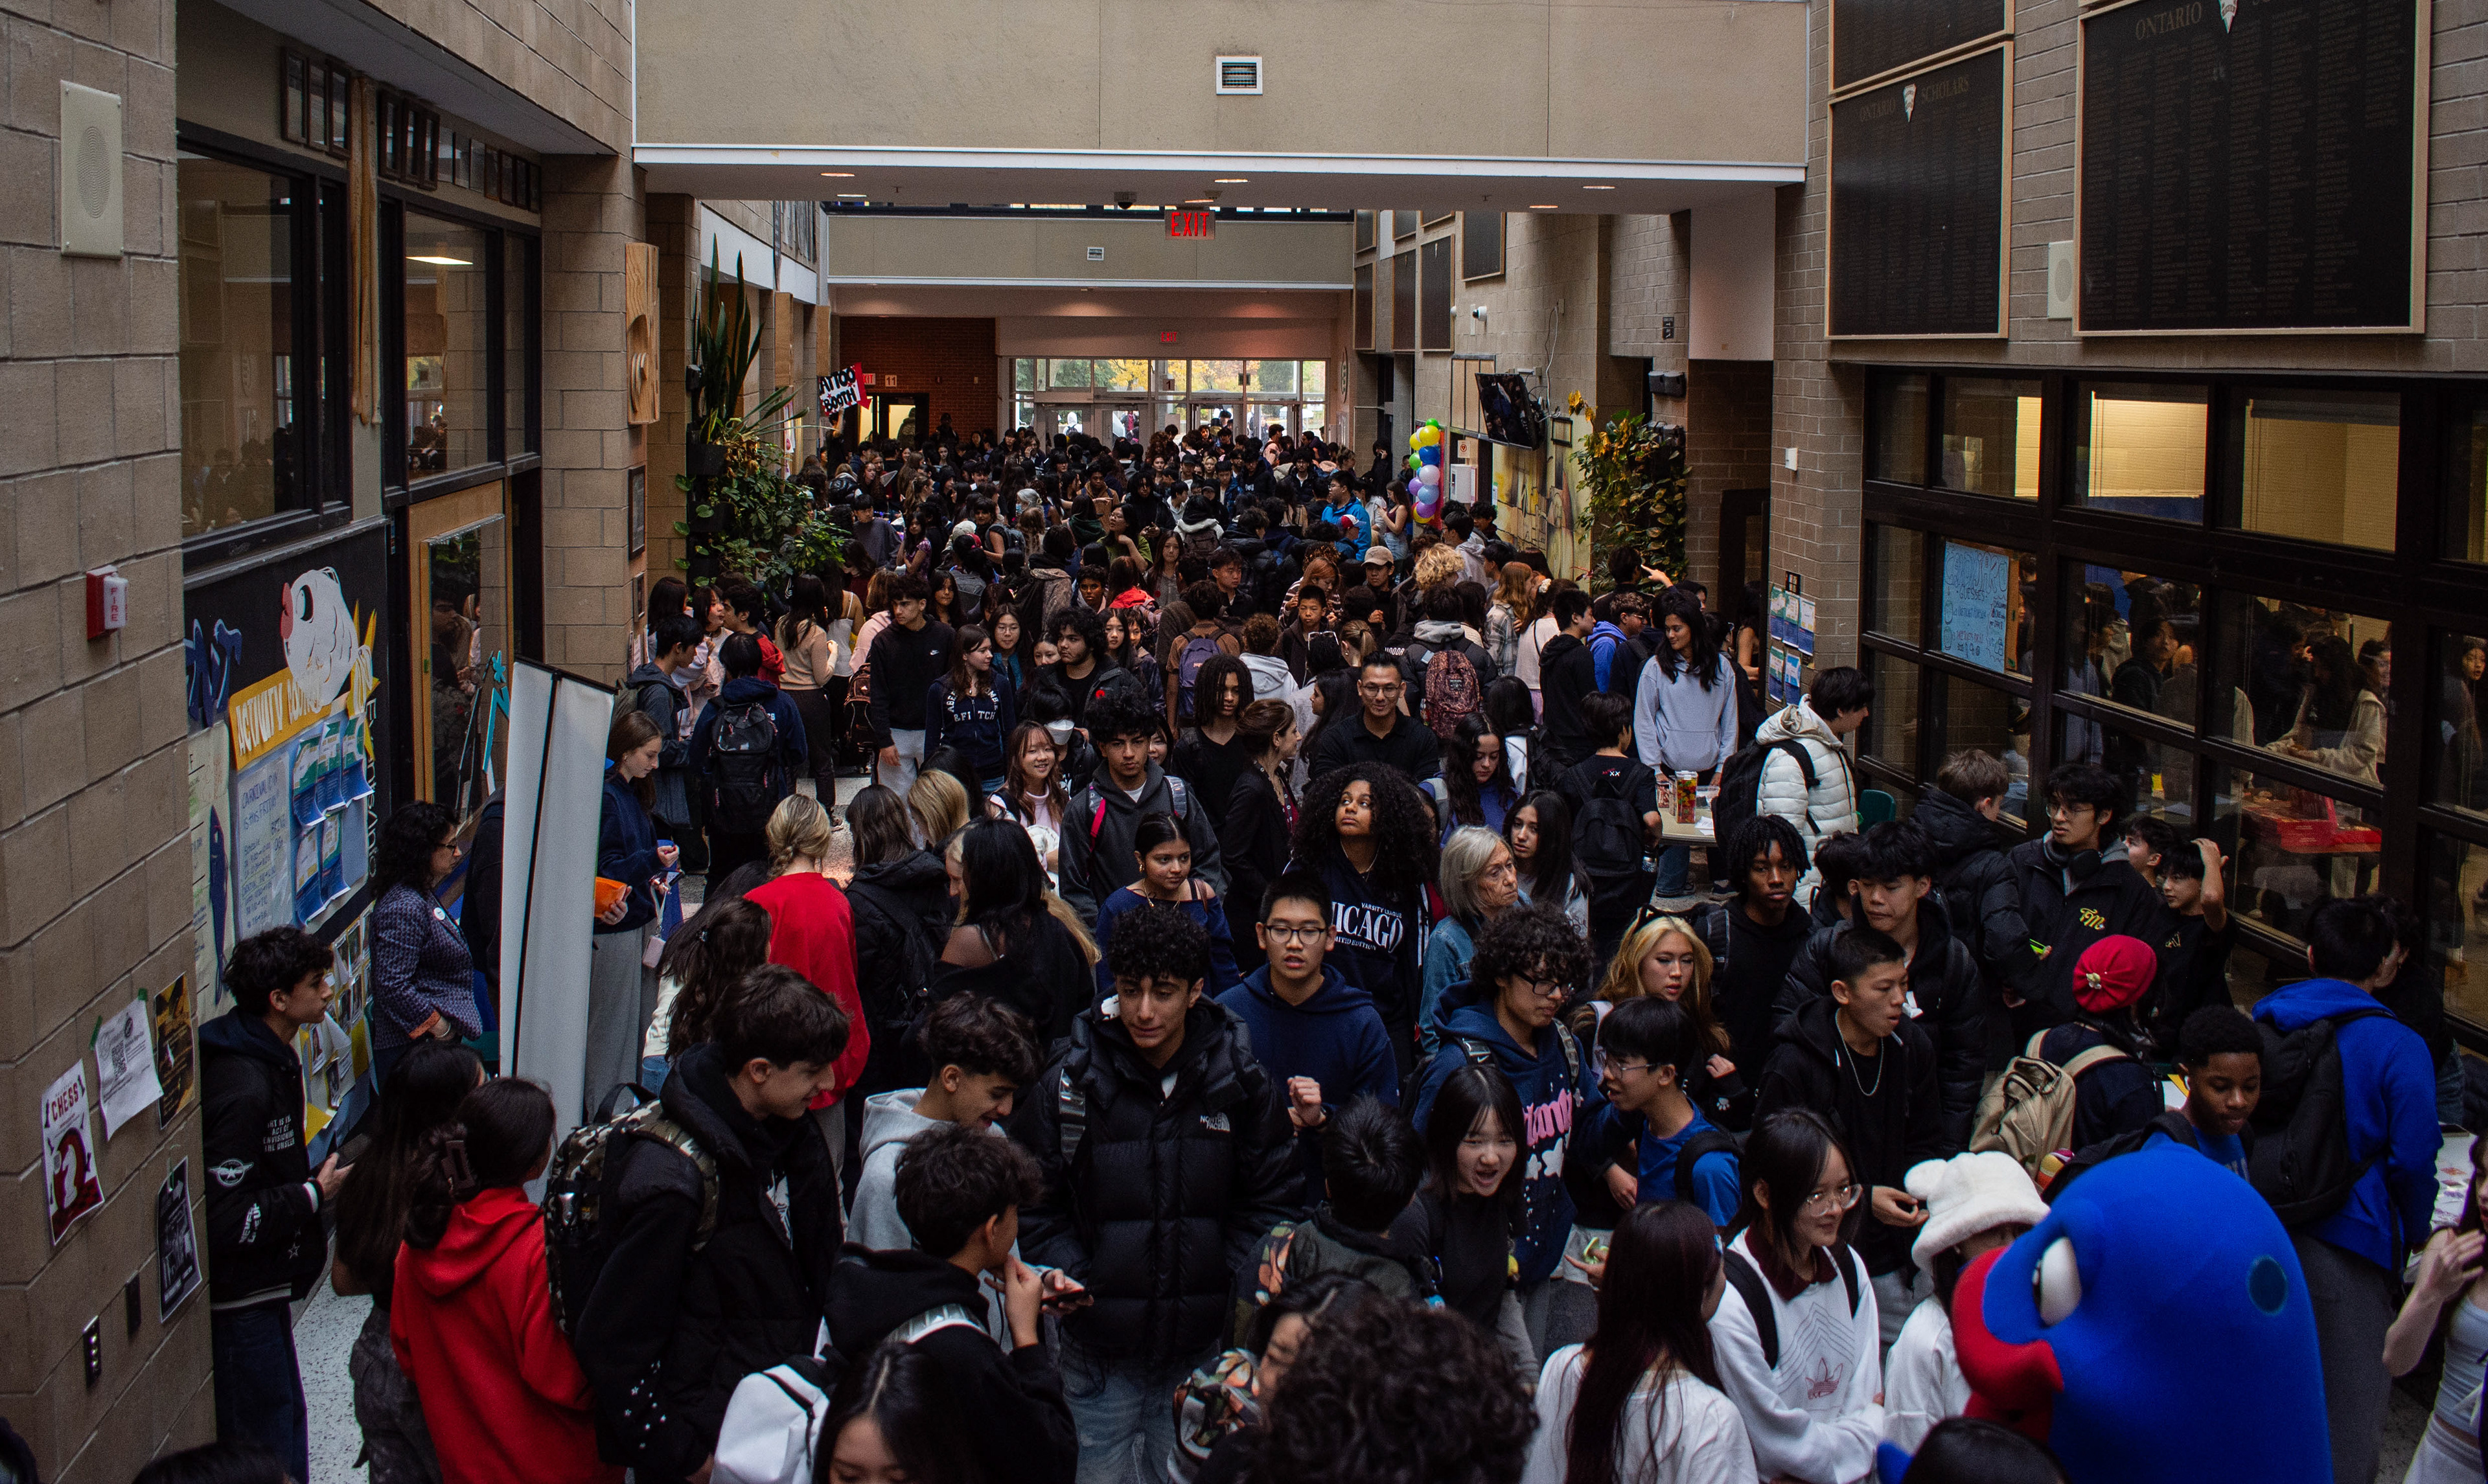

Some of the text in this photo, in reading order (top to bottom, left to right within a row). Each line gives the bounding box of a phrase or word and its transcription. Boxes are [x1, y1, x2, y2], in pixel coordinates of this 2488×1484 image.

[2135, 1, 2203, 41] ONTARIO
[1860, 73, 1969, 122] ONTARIO SCHOLARS
[1171, 212, 1210, 236] EXIT
[1161, 332, 1178, 342] EXIT
[820, 367, 857, 394] ATTOO
[863, 374, 873, 384] XIT
[886, 376, 896, 385] 11
[1166, 380, 1171, 390] 1
[823, 387, 857, 413] BOOTH
[110, 587, 119, 622] FIRE
[236, 682, 283, 757] ACTIVITY
[1361, 902, 1403, 919] VARSITY LEAGUE
[1331, 901, 1403, 953] ICAGO
[1334, 935, 1377, 951] MITED EDITION
[51, 1082, 80, 1122] CHESS
[272, 1126, 282, 1136] ACT
[1200, 1114, 1221, 1124] NORTH
